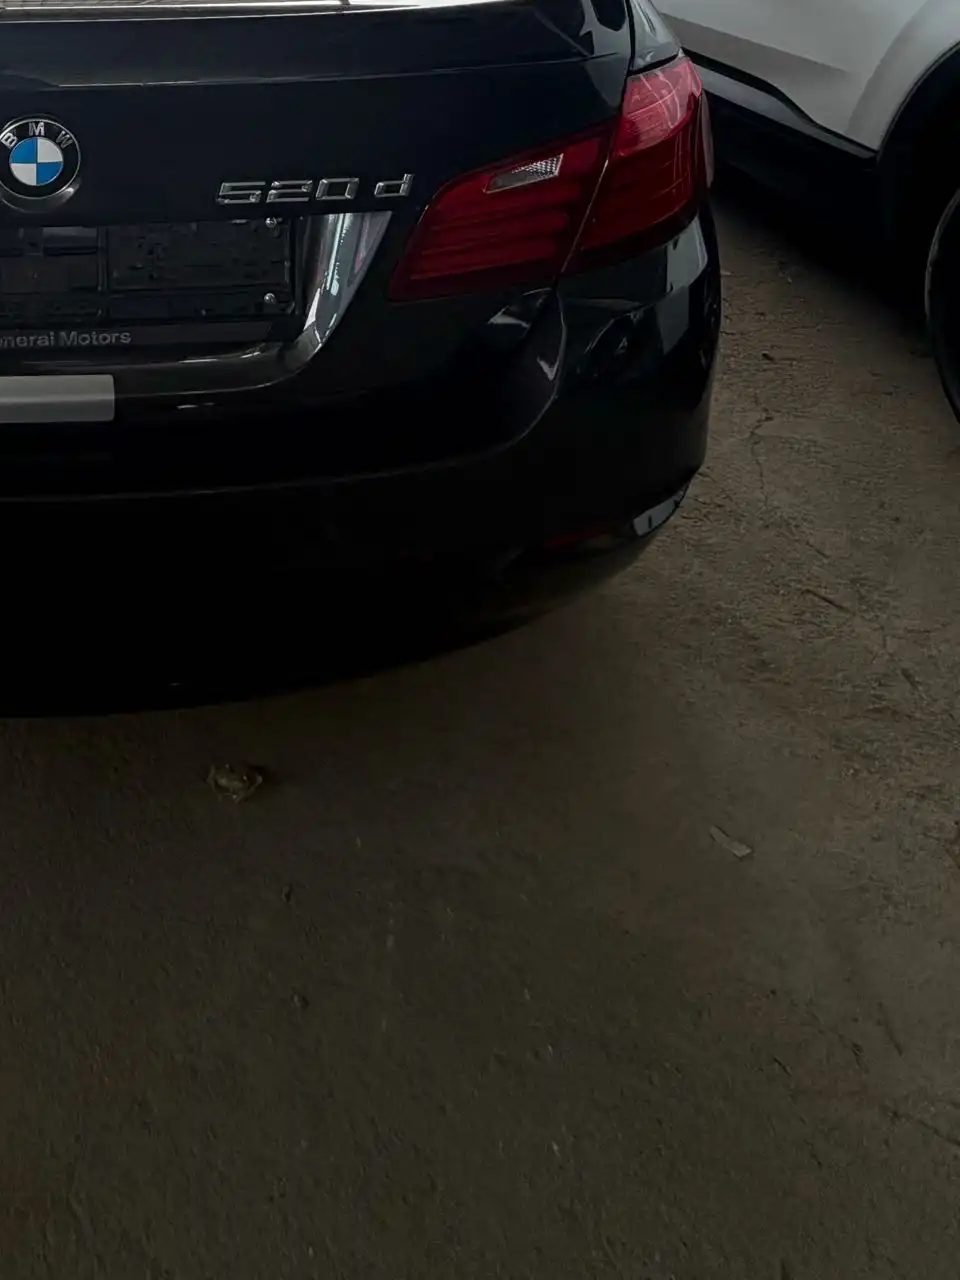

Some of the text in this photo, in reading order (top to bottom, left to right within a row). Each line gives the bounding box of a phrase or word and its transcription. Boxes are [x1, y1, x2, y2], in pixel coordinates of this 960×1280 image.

[0, 121, 73, 149] BMW
[216, 173, 415, 205] 520 d
[60, 330, 132, 347] Motors
